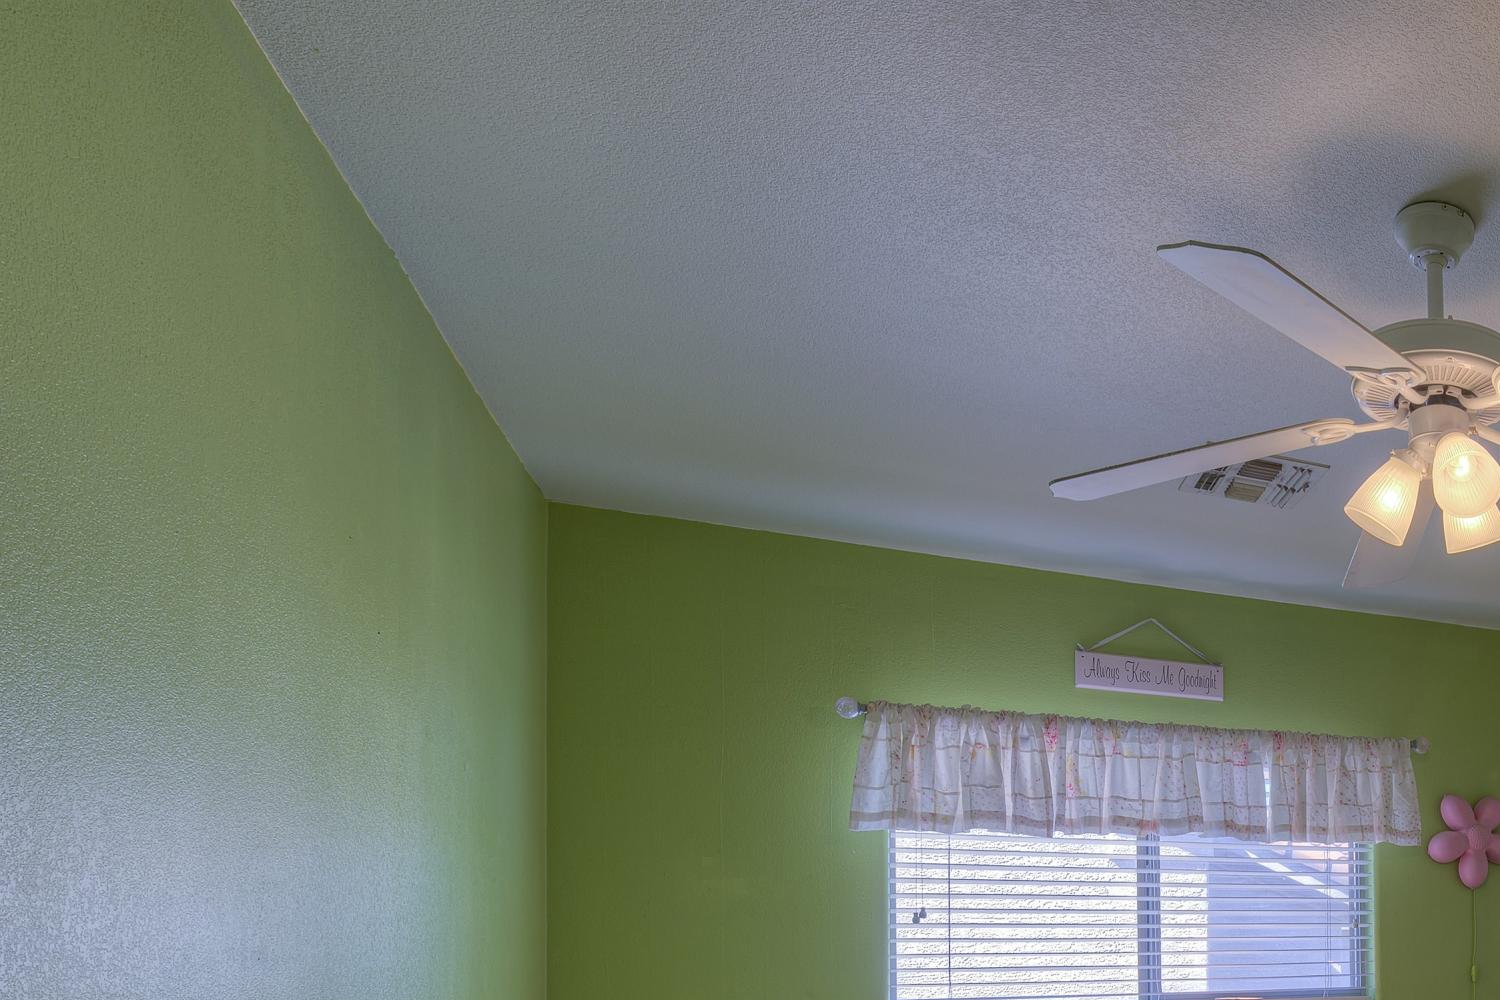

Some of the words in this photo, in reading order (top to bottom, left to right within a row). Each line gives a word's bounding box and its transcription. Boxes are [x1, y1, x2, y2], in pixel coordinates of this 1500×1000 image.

[1083, 657, 1120, 685] Always
[1124, 660, 1151, 684] Kiss
[1155, 665, 1174, 686] Me
[1178, 667, 1217, 694] Goodnight
